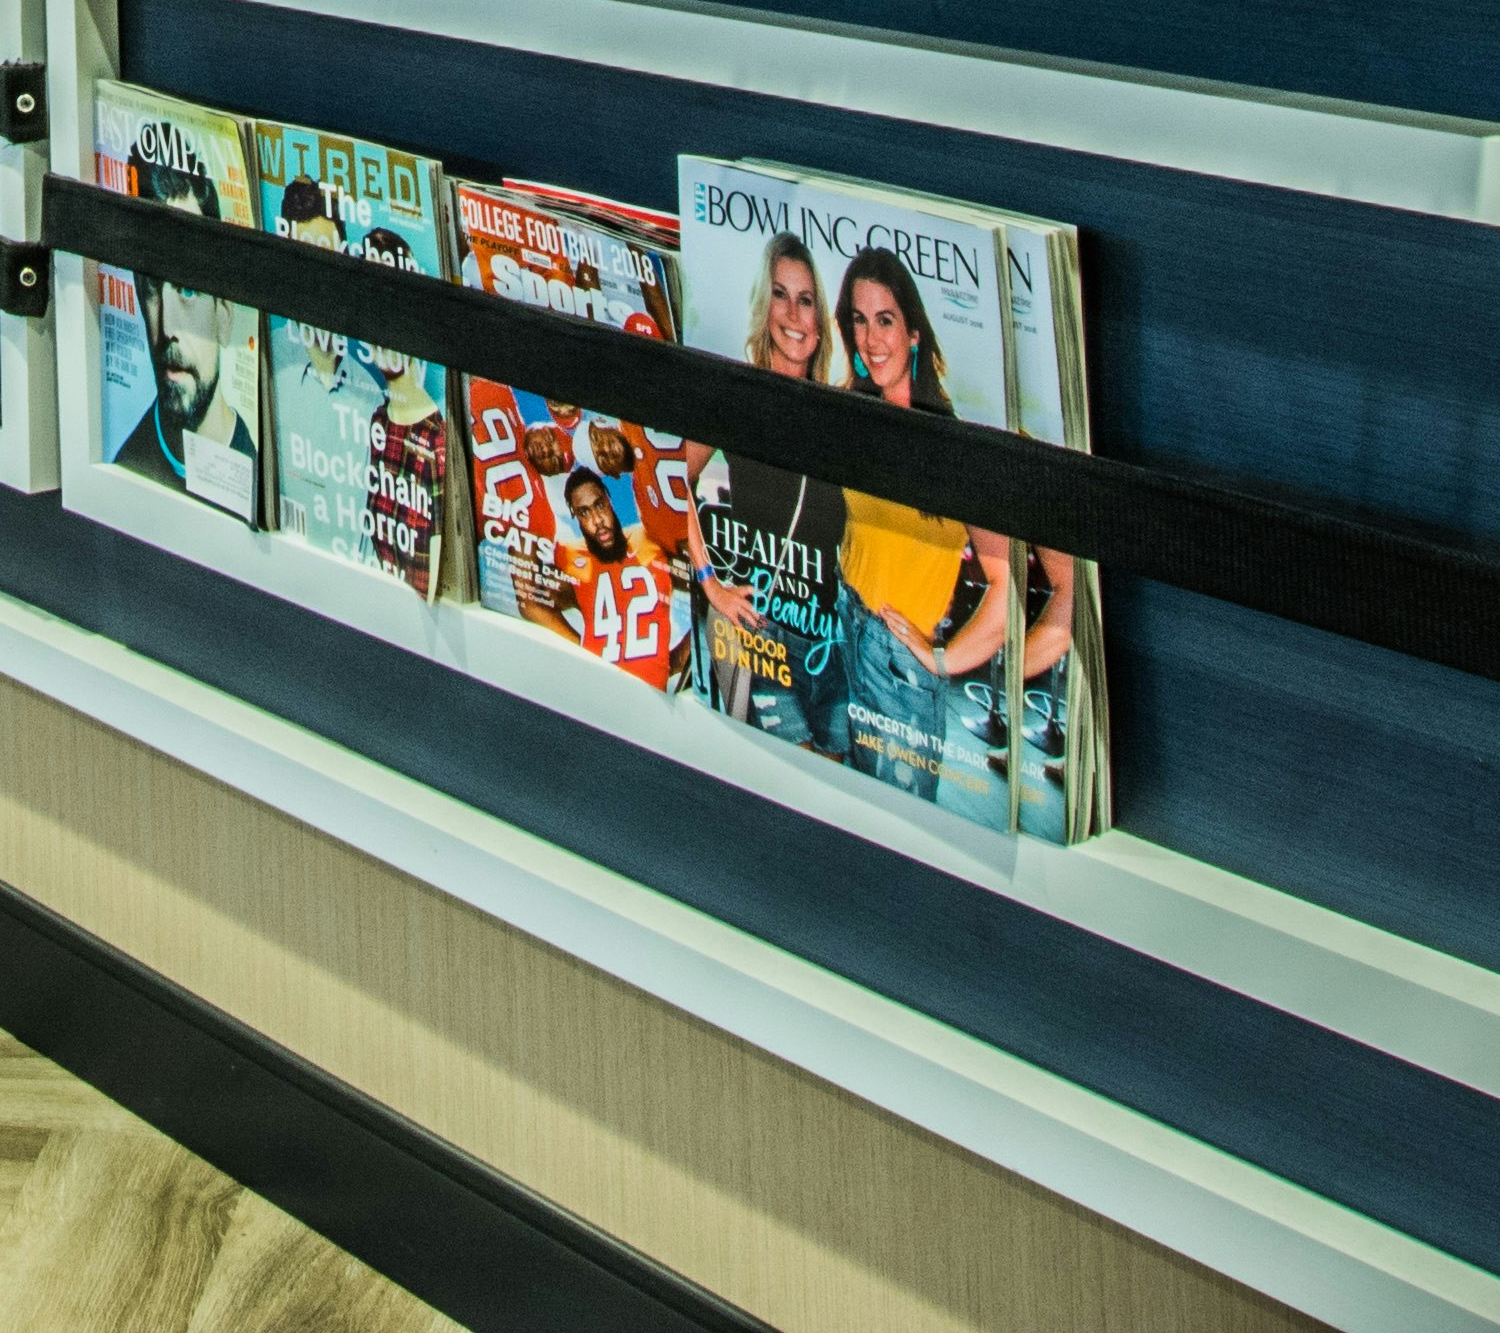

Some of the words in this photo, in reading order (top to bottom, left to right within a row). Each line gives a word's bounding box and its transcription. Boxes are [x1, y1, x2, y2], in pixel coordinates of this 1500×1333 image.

[257, 133, 417, 209] WIRED
[319, 181, 372, 228] The
[695, 182, 707, 222] VIP
[459, 195, 525, 245] COLLEGE
[525, 217, 609, 277] FOOTBALL
[610, 243, 656, 287] 2018
[707, 184, 858, 259] BOWLING
[866, 223, 980, 289] GREEN
[490, 254, 635, 332] Sports
[286, 318, 348, 356] Love
[942, 313, 968, 327] AUGUST
[332, 403, 387, 451] The
[290, 433, 433, 520] Blockchain:
[313, 493, 330, 524] a
[336, 493, 418, 558] Horror
[482, 492, 530, 529] BIG
[483, 521, 556, 566] CATS
[484, 546, 540, 573] Clemson's
[711, 512, 824, 584] HEALTH
[510, 565, 532, 581] Best
[775, 574, 810, 599] AND
[593, 564, 659, 663] 42
[751, 565, 840, 675] Beauty
[713, 638, 793, 688] DINING
[714, 618, 787, 663] OUTDOOR
[847, 702, 915, 744] CONCERTS
[914, 727, 928, 748] IN
[930, 734, 955, 757] THE
[957, 747, 991, 773] PARK
[855, 731, 884, 755] JAKE
[886, 742, 927, 771] OWEN
[928, 759, 992, 796] CONCERT
